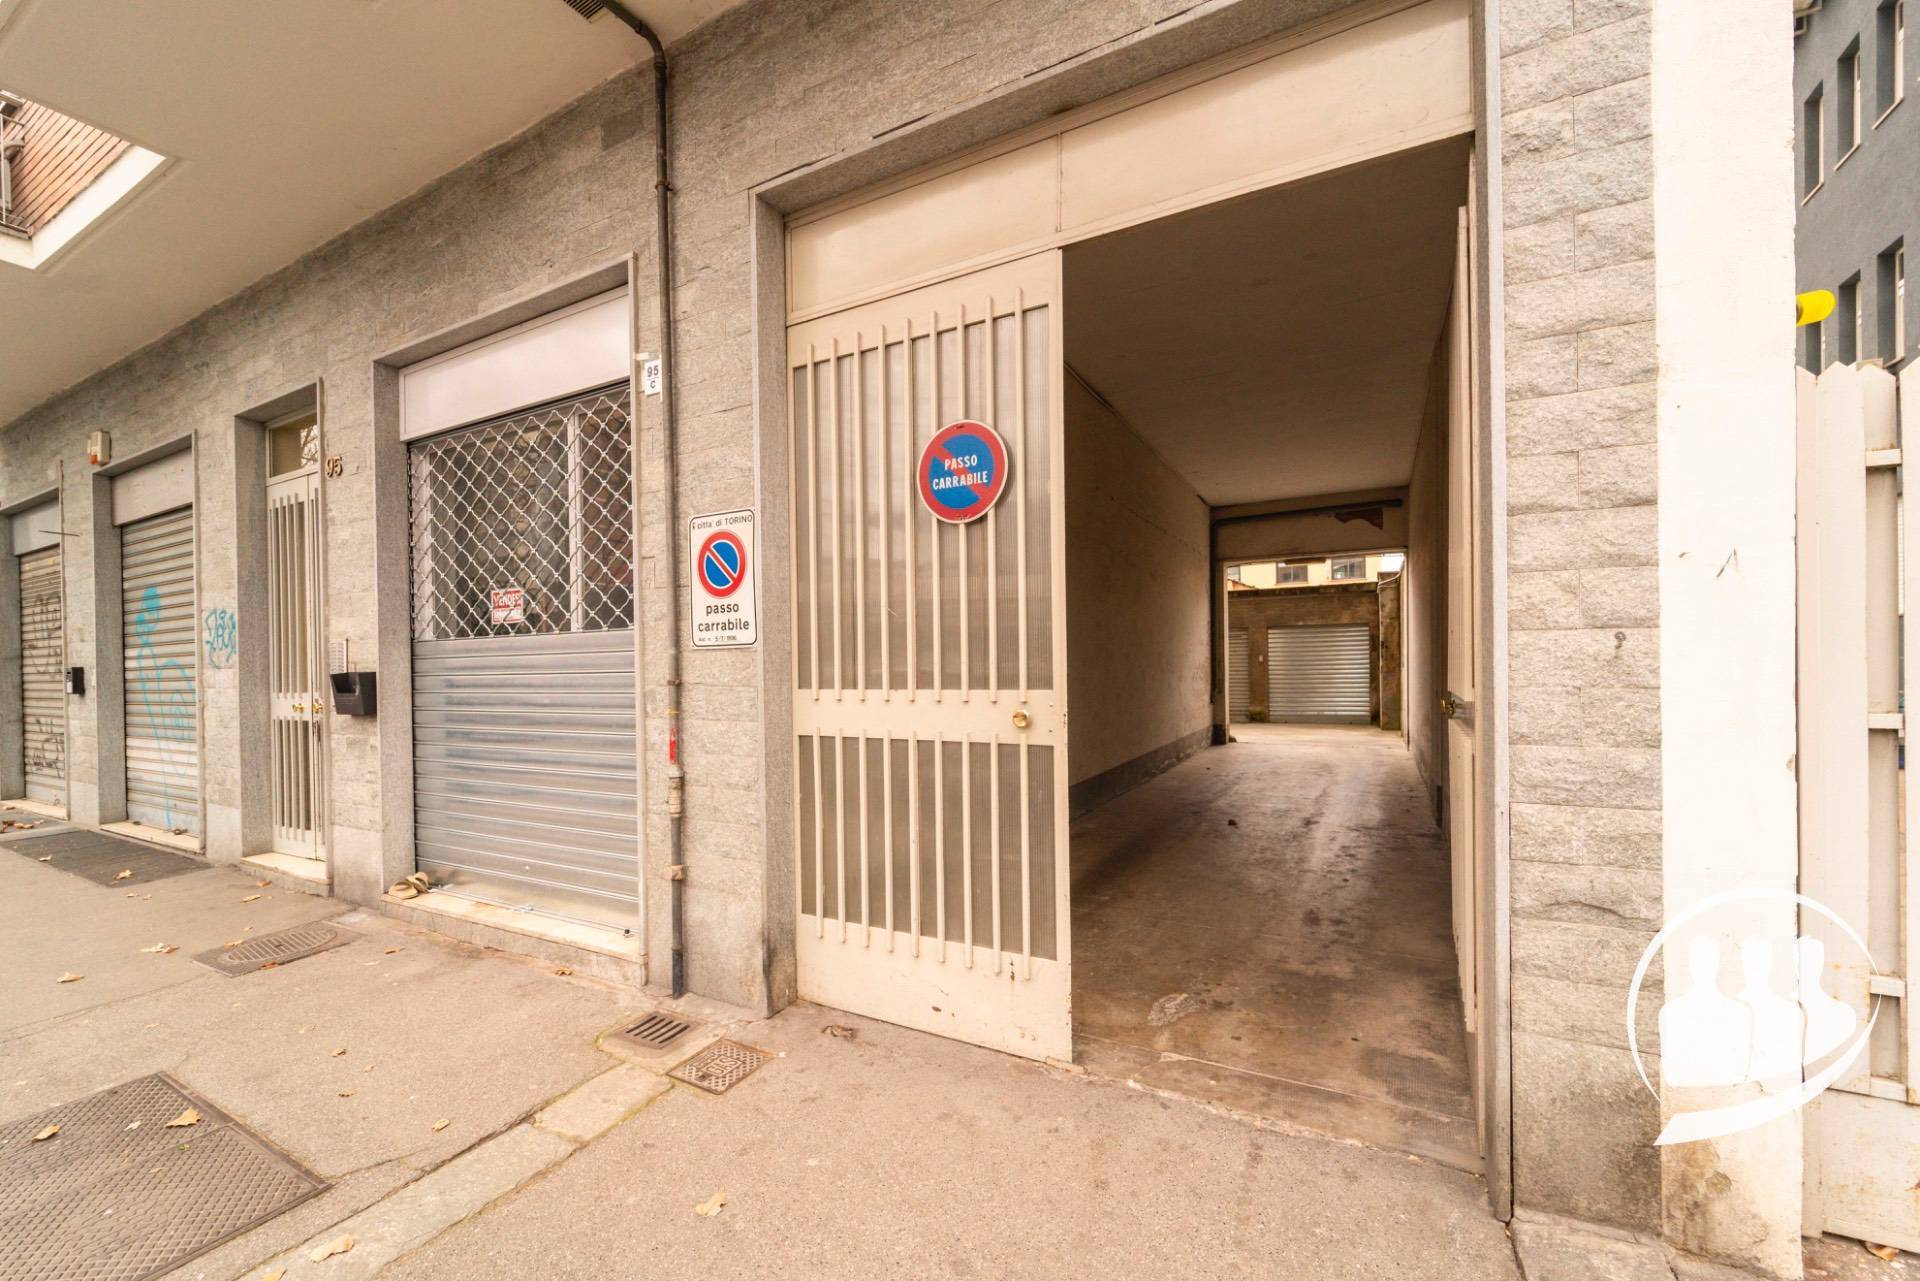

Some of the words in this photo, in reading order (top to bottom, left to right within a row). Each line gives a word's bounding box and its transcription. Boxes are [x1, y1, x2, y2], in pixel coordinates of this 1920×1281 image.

[647, 365, 658, 377] 95
[327, 456, 343, 478] 95
[944, 455, 978, 470] PASSO
[933, 471, 988, 490] CARRABILE
[715, 518, 722, 527] di
[724, 514, 752, 526] TORINO
[706, 603, 739, 616] passo
[698, 618, 750, 632] carrabile
[705, 1056, 738, 1076] GAS
